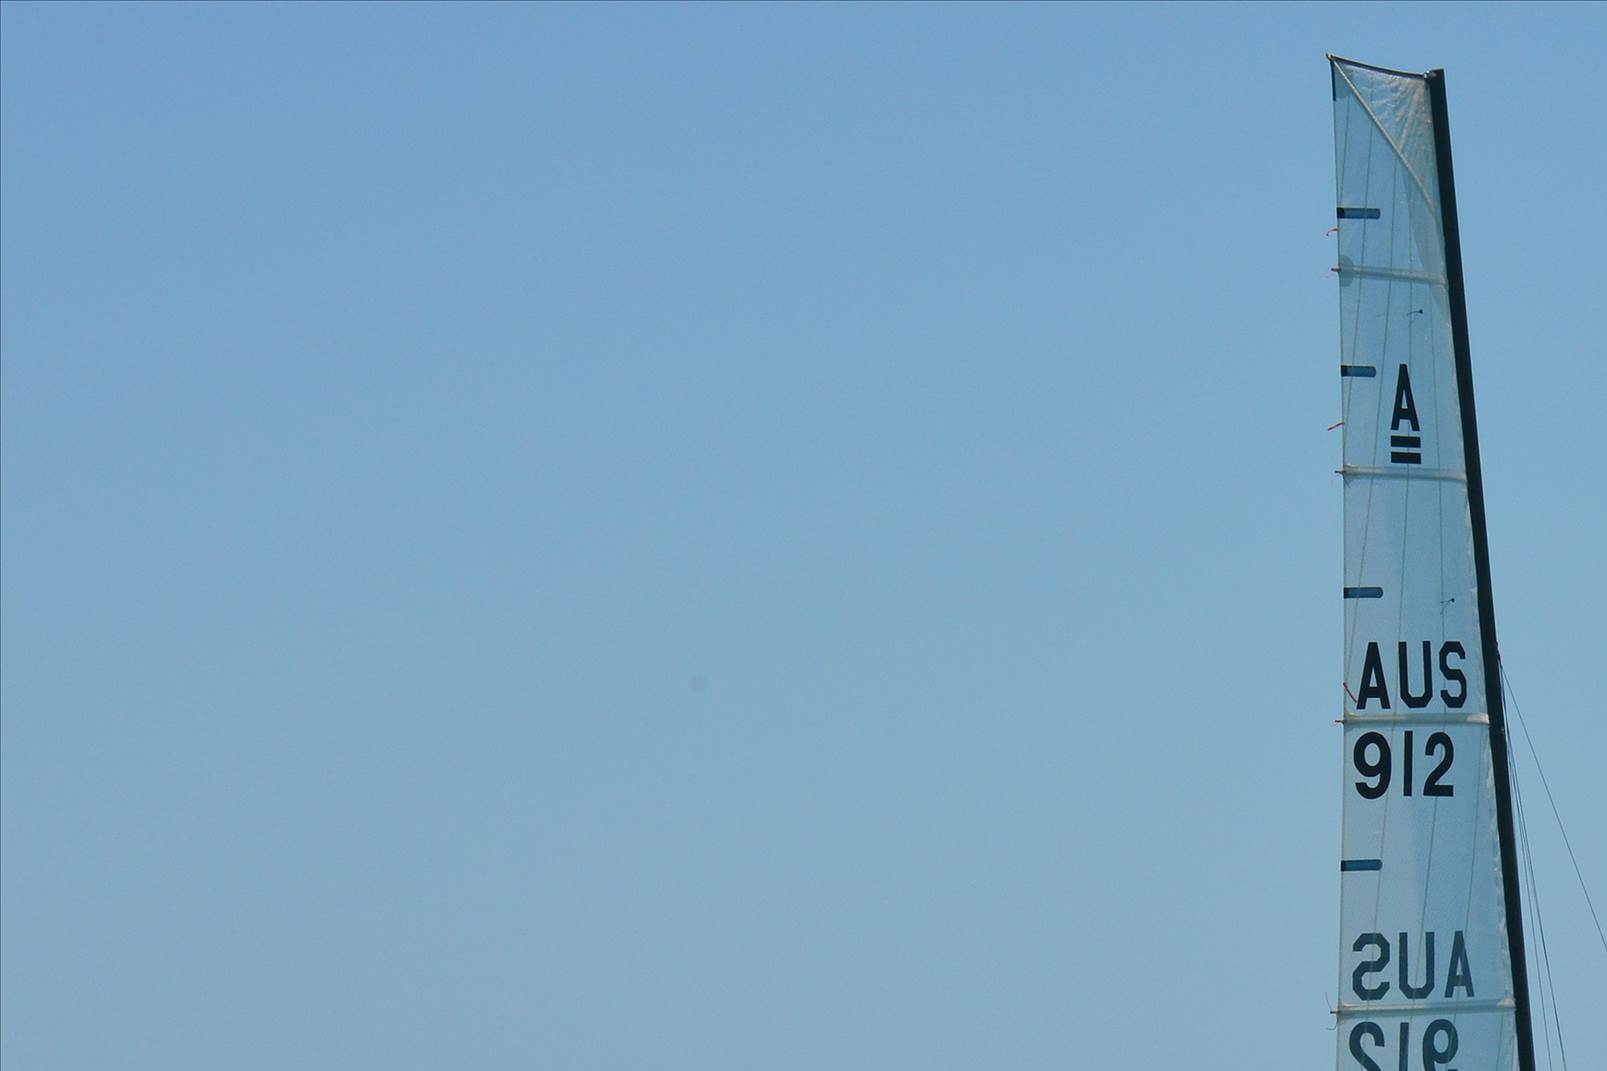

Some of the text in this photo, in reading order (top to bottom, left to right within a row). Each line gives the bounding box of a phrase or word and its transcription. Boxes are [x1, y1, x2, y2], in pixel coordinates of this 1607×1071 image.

[1391, 363, 1420, 431] A
[1356, 641, 1467, 709] AUS
[1353, 730, 1454, 799] 912
